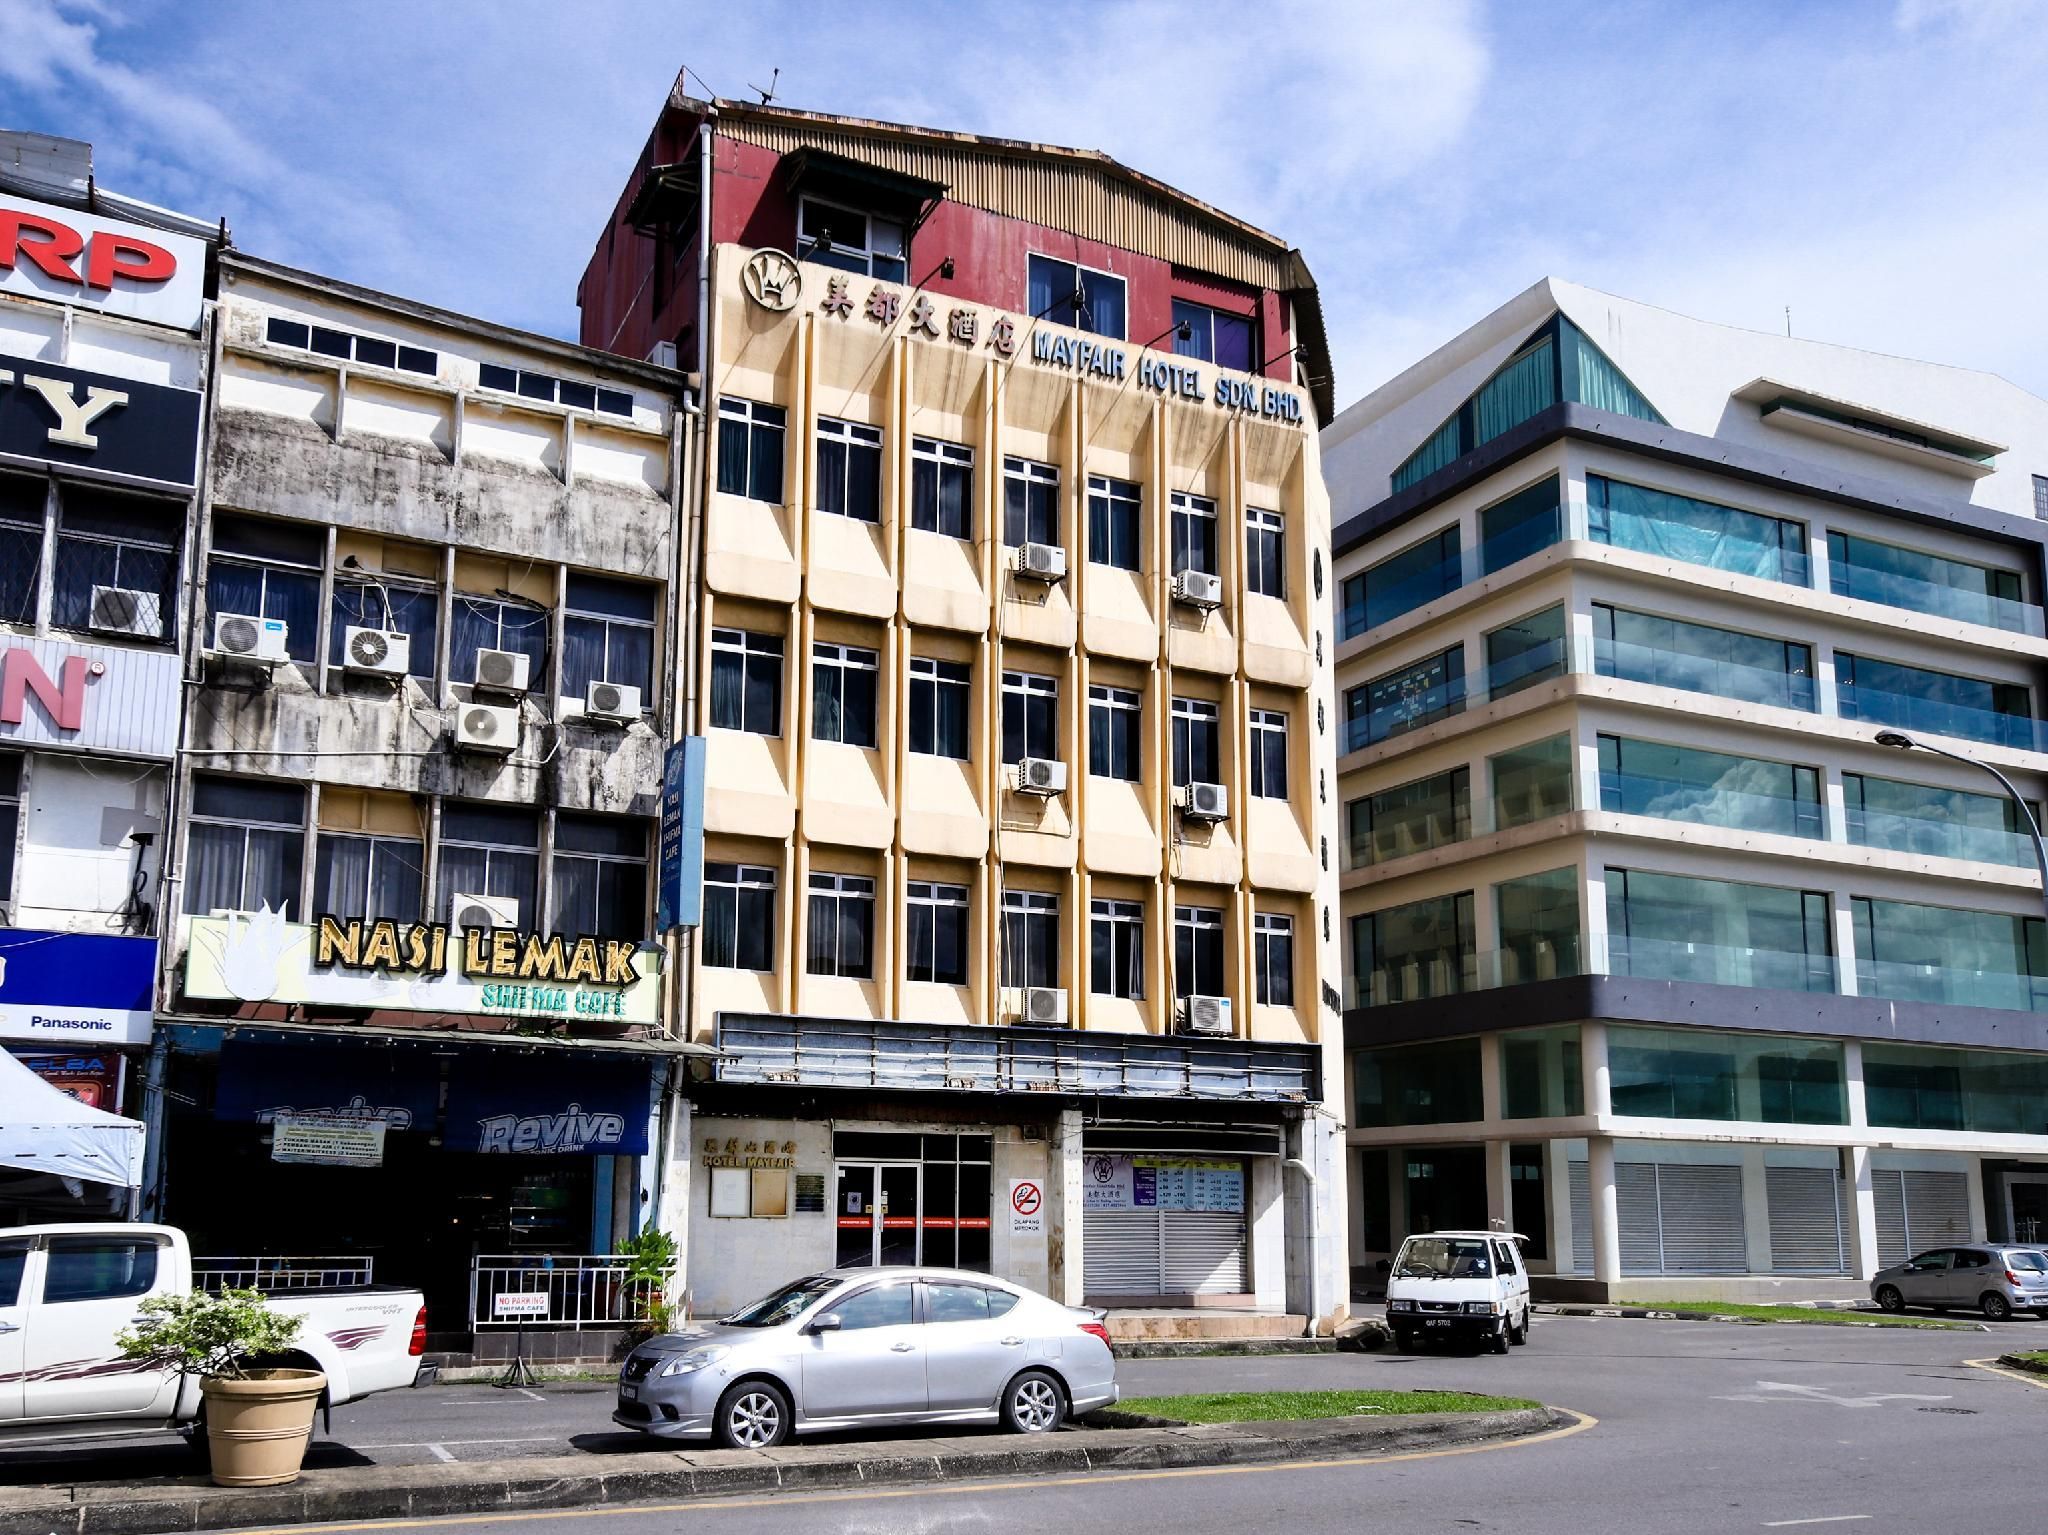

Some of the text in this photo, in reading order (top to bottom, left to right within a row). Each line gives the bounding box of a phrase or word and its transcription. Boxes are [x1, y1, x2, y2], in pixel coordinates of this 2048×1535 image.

[1034, 330, 1126, 378] MAYFAIR
[1139, 356, 1206, 401] HOTEL
[1263, 386, 1304, 424] BHD.
[0, 369, 129, 450] Y
[315, 914, 642, 985] NASI LEMAK
[31, 1015, 113, 1031] Panasonic
[28, 1057, 105, 1070] ELBA
[477, 1103, 625, 1154] Revive
[557, 1144, 585, 1153] DRINK
[703, 1155, 742, 1168] HOTEL
[499, 1296, 545, 1305] NO PARKING
